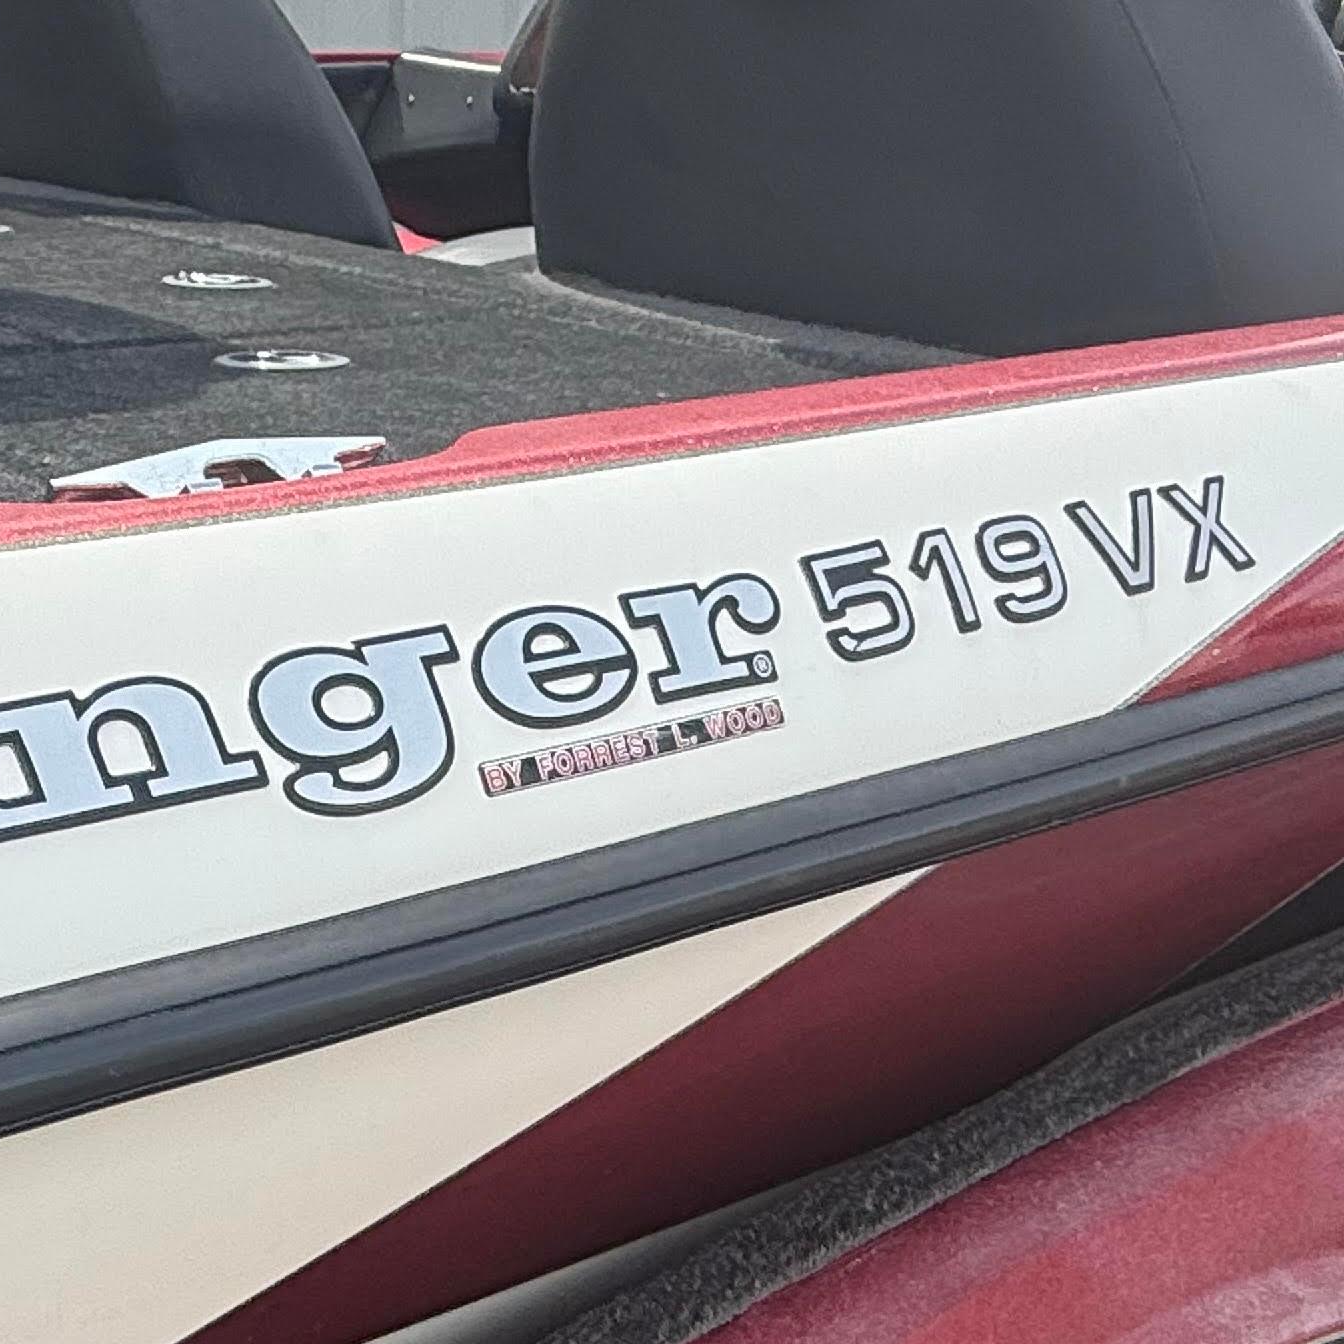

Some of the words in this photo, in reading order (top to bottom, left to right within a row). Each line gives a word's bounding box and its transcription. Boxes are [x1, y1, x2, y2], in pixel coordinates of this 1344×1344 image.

[799, 515, 1068, 661] 519
[1064, 475, 1255, 596] VX
[484, 763, 522, 793] BY
[536, 730, 659, 780] FORREST
[671, 723, 698, 748] L.
[703, 701, 783, 737] WOOD
